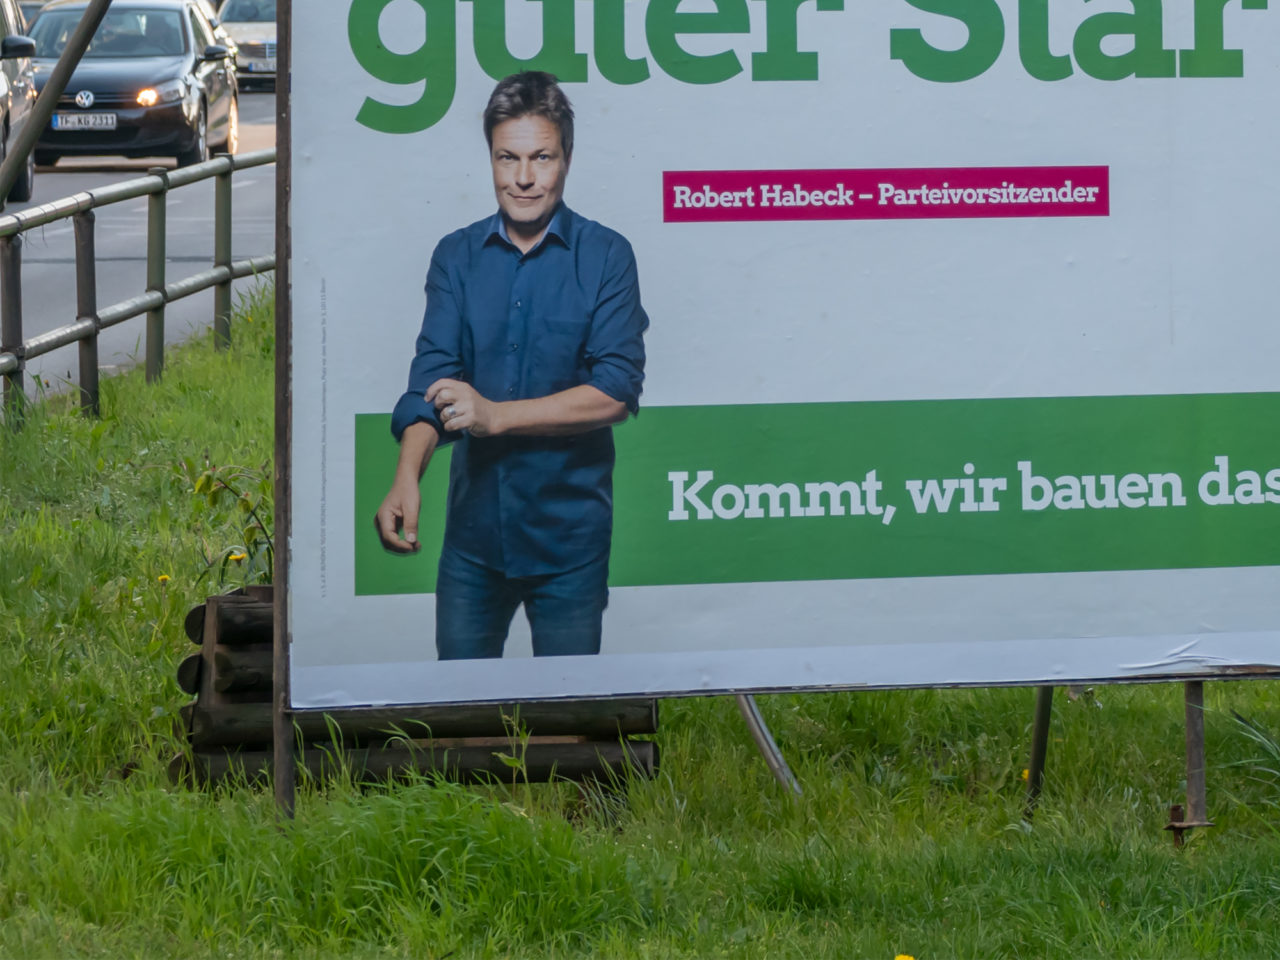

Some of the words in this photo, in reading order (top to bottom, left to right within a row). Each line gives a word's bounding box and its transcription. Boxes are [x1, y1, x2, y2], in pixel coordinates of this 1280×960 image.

[674, 184, 755, 208] Robert
[760, 183, 853, 207] Habeck
[878, 181, 1099, 206] Parteivorsitzender
[668, 470, 896, 524] Kommt,
[906, 463, 1006, 513] wir
[1018, 461, 1186, 510] bauen
